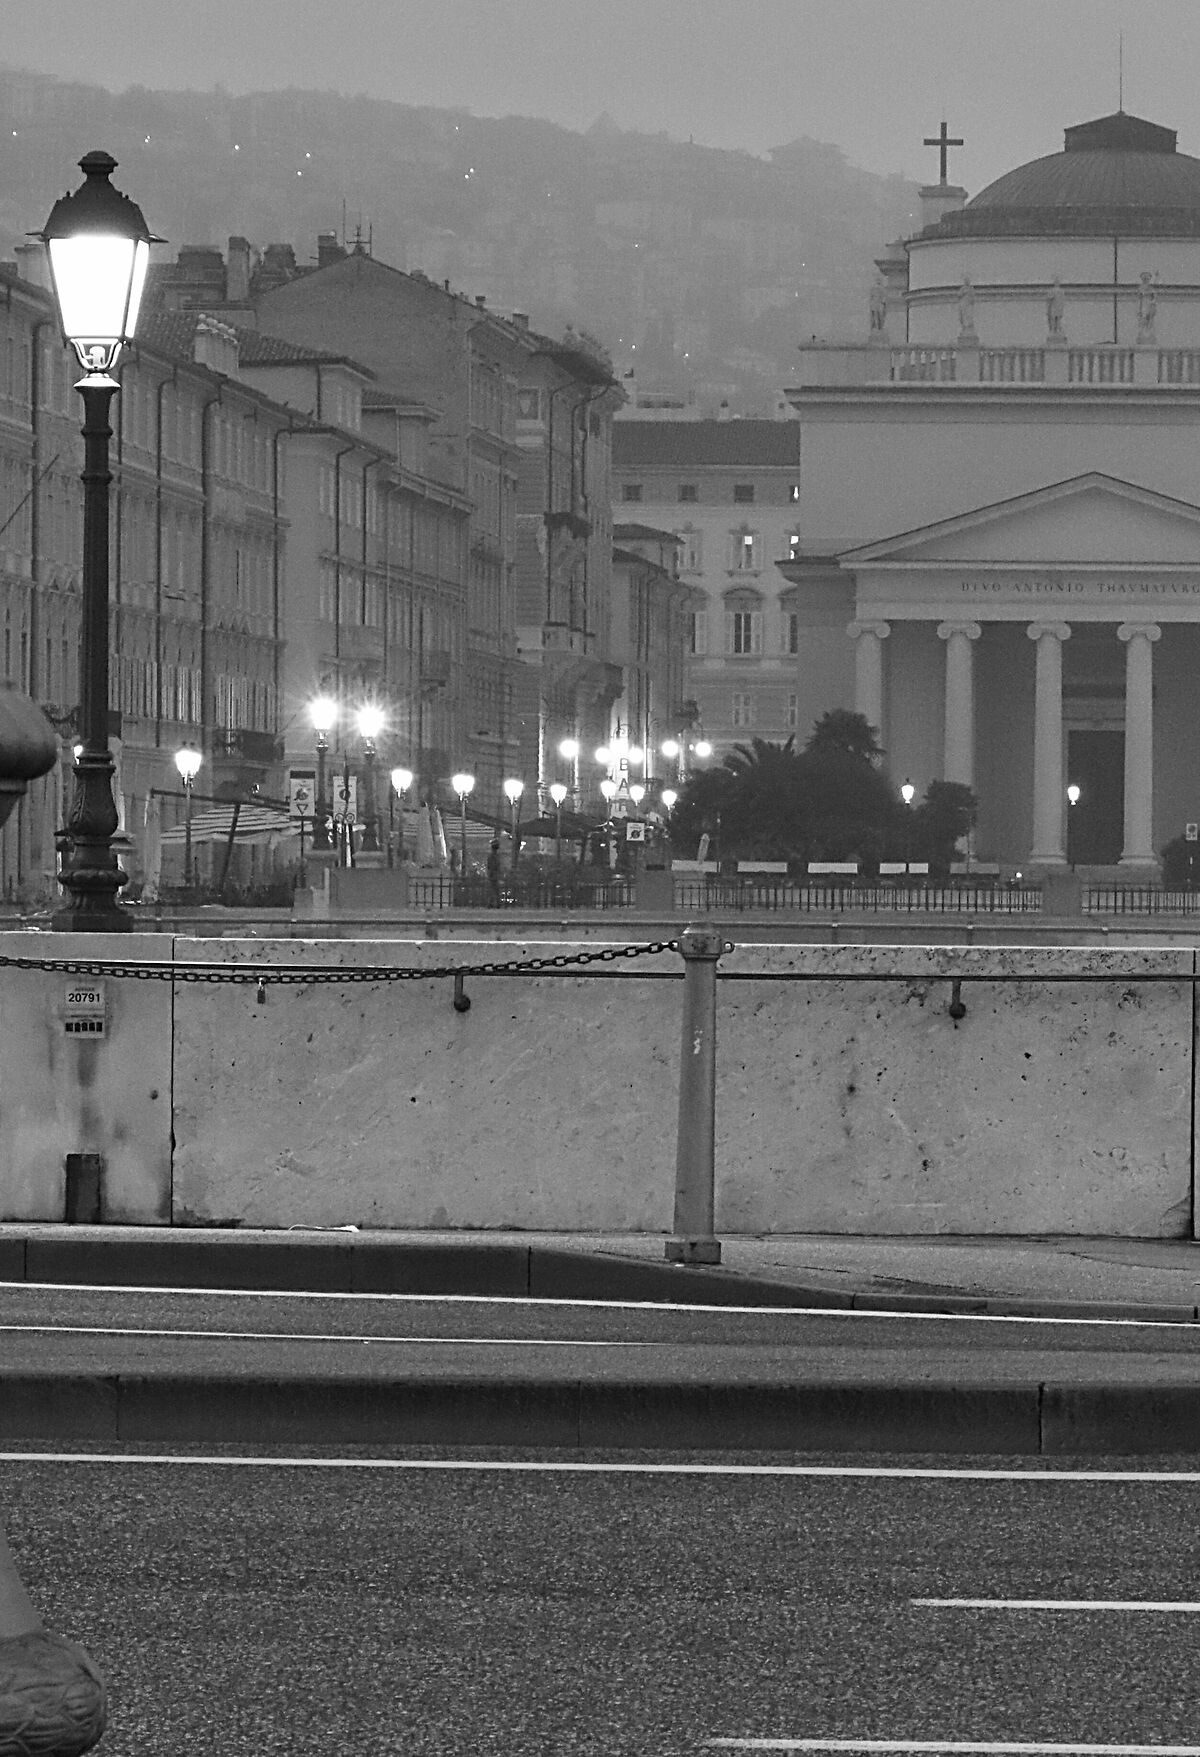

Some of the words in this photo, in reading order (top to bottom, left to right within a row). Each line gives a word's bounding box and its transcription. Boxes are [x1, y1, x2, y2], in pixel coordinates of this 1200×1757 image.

[961, 582, 1001, 592] DIVO
[1014, 582, 1083, 593] ANTONIO
[68, 993, 100, 1003] 20791
